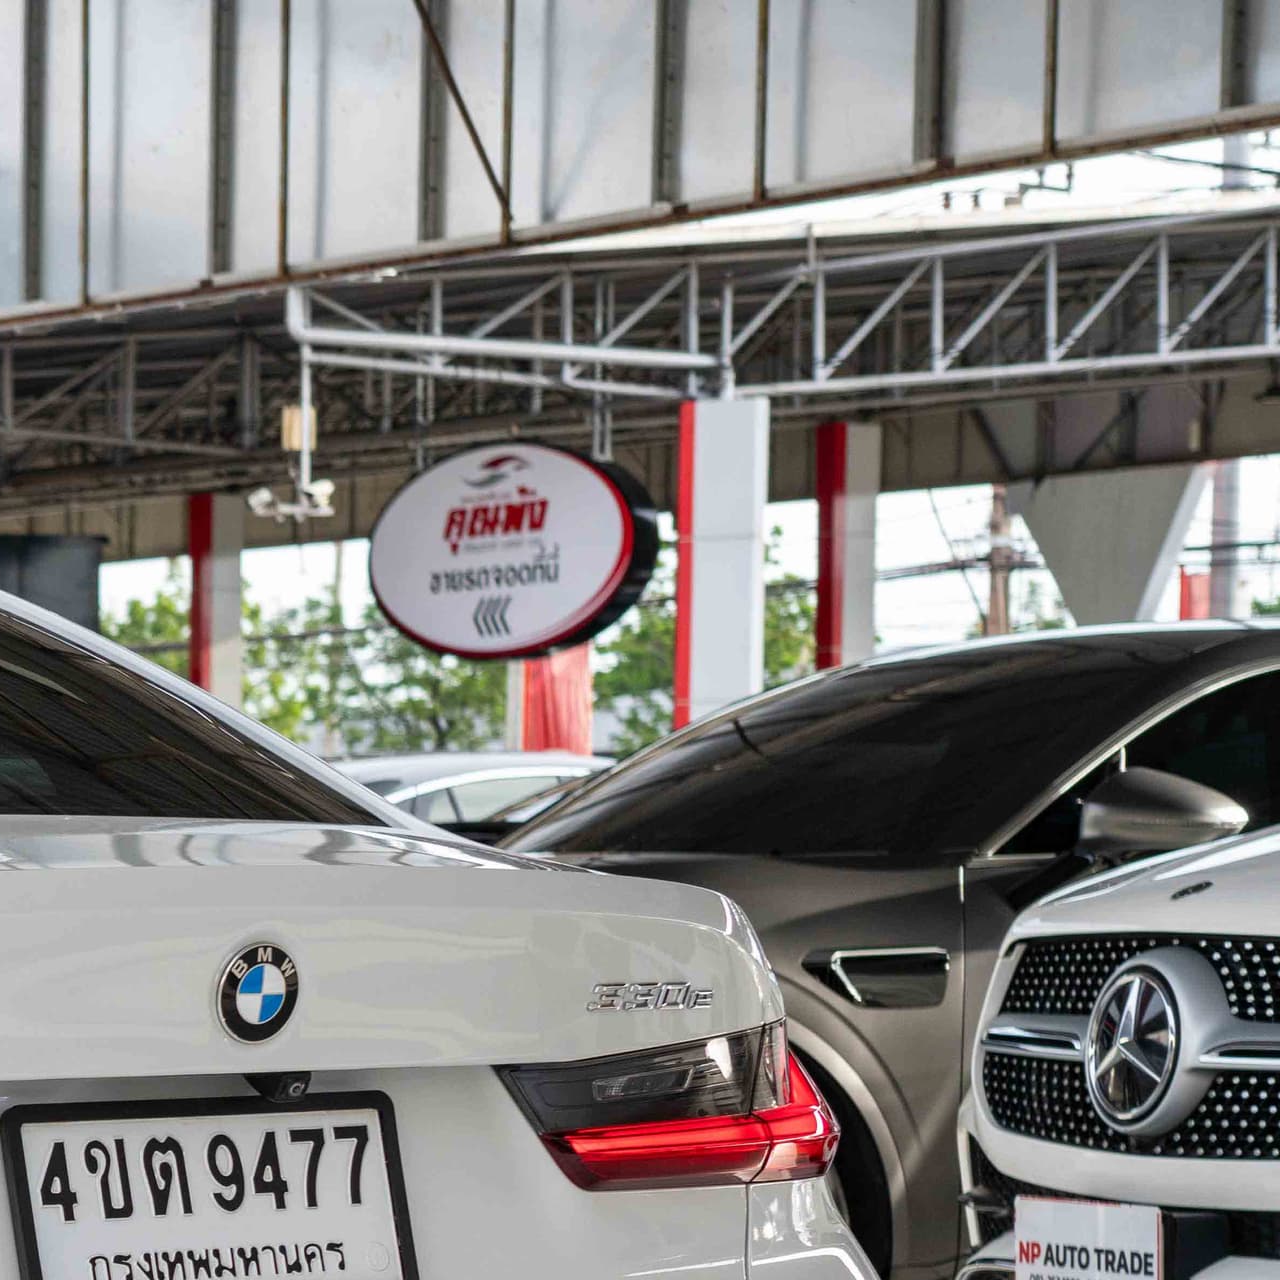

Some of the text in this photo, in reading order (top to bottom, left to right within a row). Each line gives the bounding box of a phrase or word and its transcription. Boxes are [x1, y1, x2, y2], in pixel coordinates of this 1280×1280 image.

[231, 947, 296, 979] BMW
[205, 1124, 371, 1213] 9477
[1018, 1240, 1154, 1276] NP AUTO TRADE
